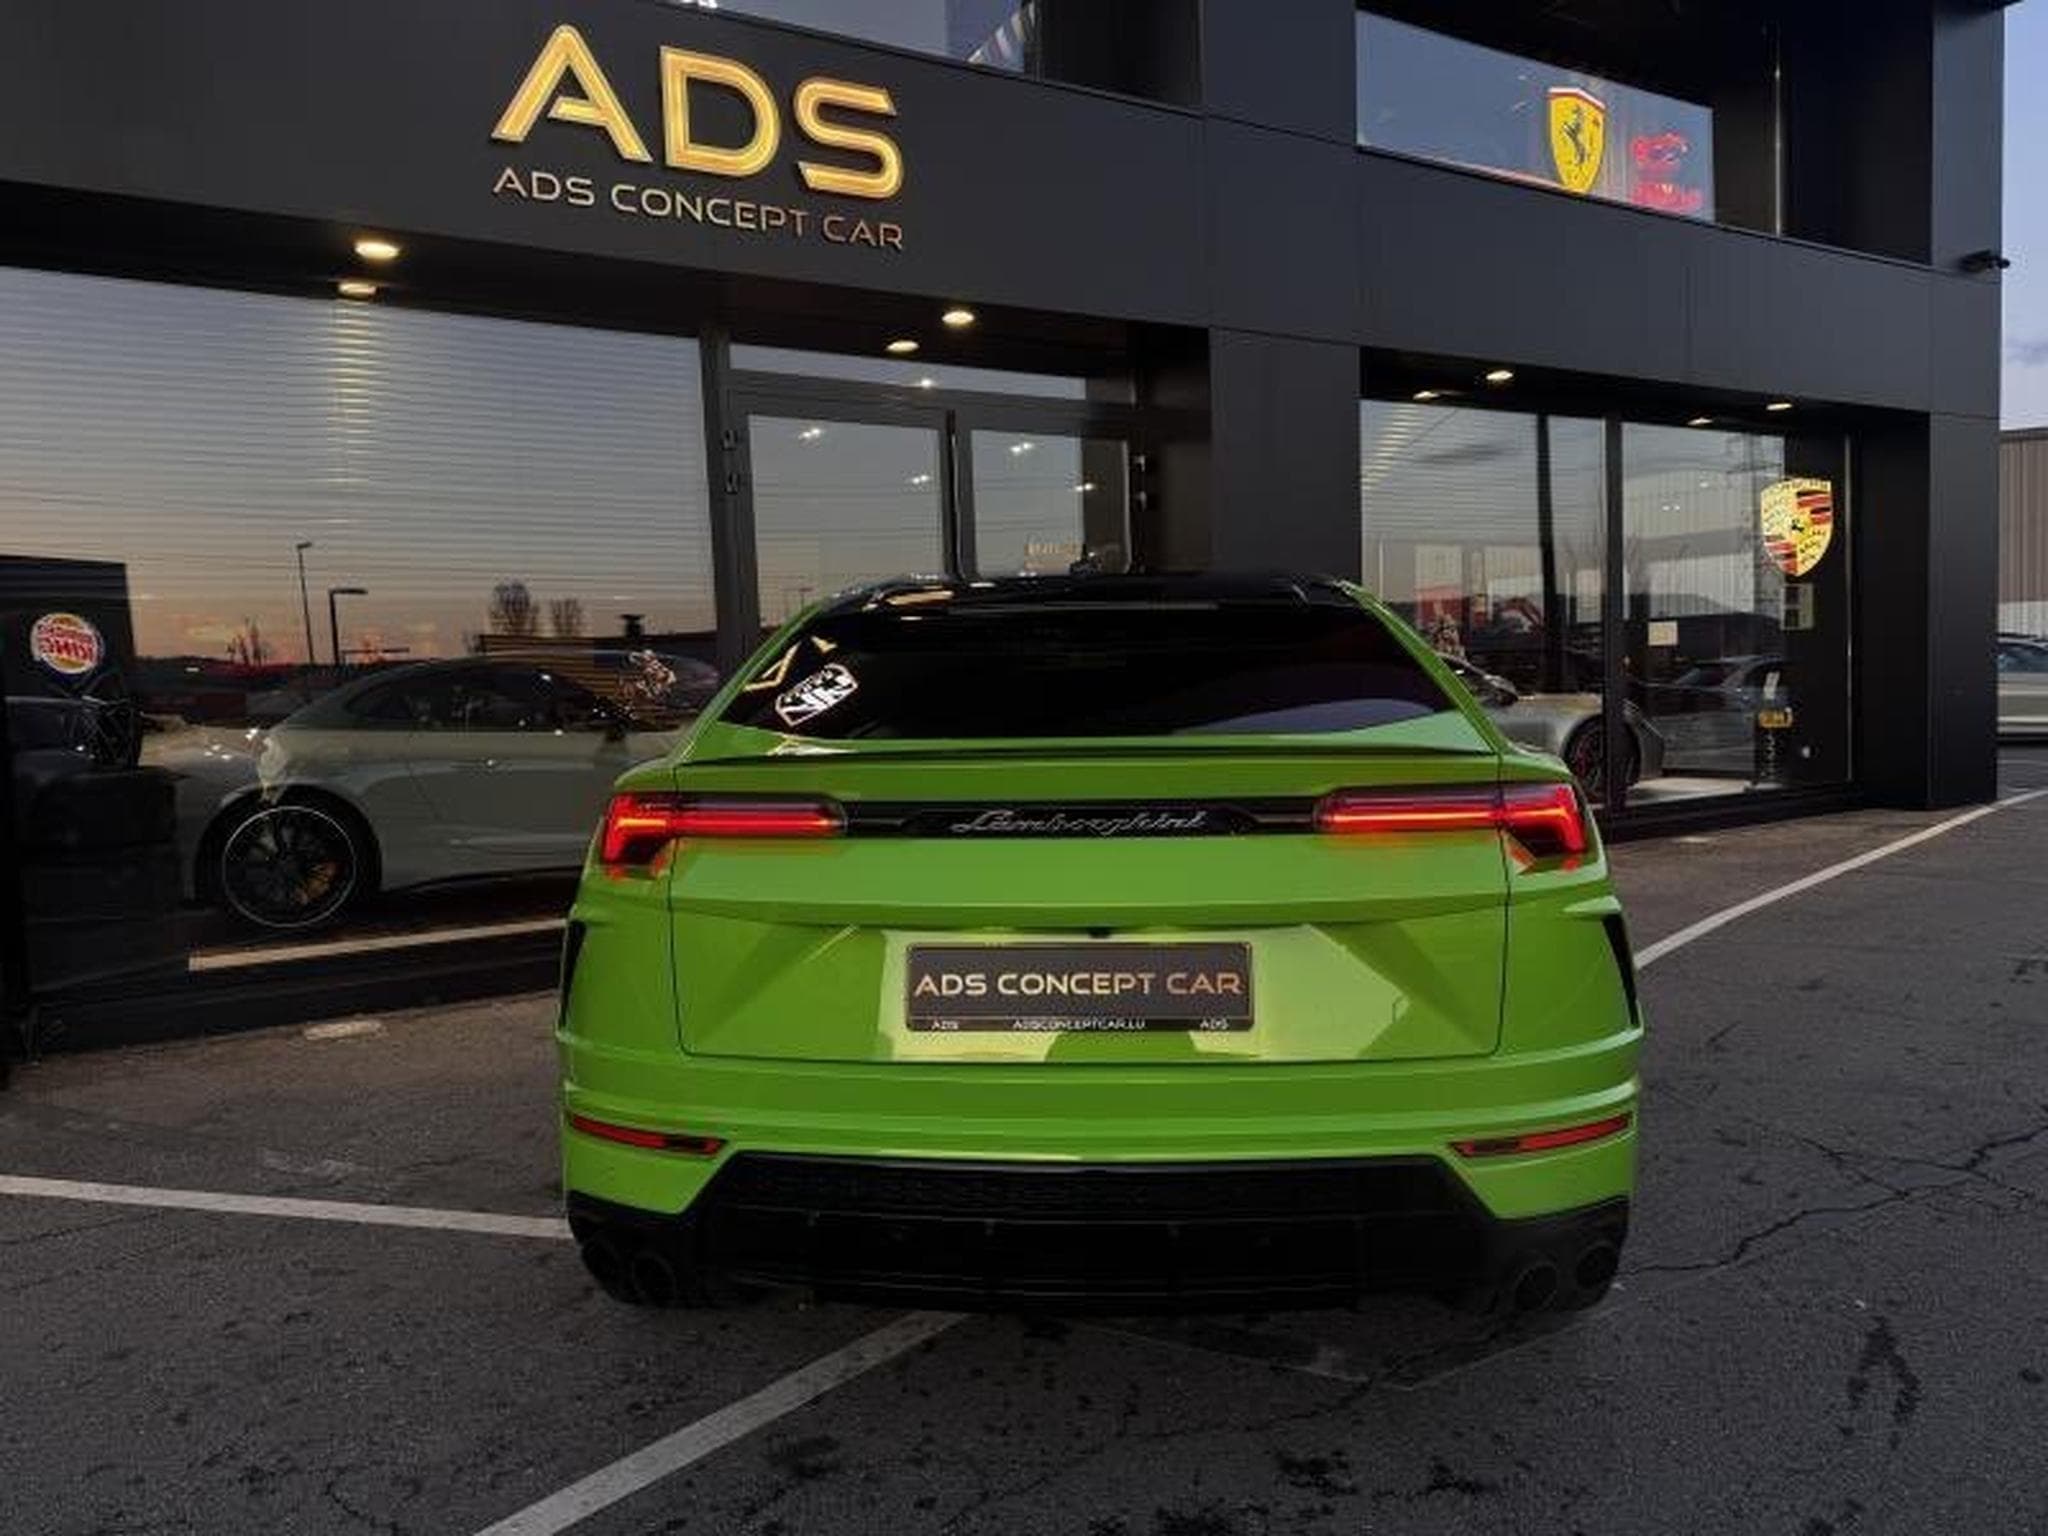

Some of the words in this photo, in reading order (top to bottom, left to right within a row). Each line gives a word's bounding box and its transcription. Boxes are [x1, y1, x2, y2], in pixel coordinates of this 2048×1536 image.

[491, 24, 904, 199] ADS
[493, 167, 595, 206] ADS
[611, 184, 807, 239] CONCEPT
[823, 215, 904, 251] CAR
[950, 810, 1206, 835] Lamborghini
[914, 972, 988, 996] ADS
[997, 971, 1156, 996] CONCEPT
[1166, 972, 1243, 995] CAR
